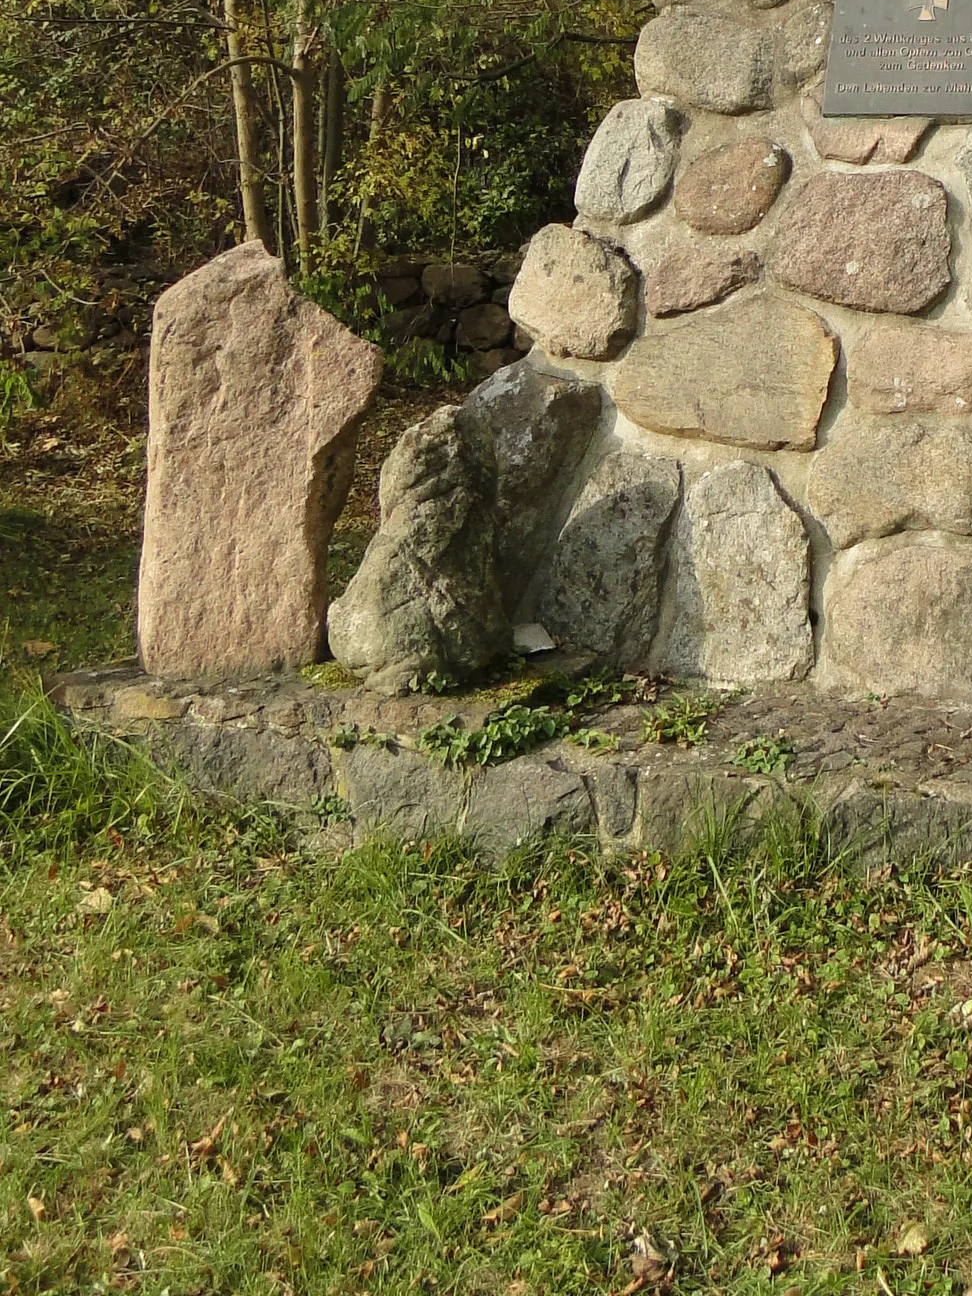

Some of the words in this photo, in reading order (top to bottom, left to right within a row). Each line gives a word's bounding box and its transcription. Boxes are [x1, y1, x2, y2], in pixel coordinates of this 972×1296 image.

[839, 33, 859, 44] des
[845, 46, 867, 57] und
[870, 46, 896, 57] allen
[899, 46, 938, 59] Opfern
[943, 47, 962, 57] von
[879, 61, 903, 70] zum
[836, 82, 860, 94] Den
[863, 82, 919, 94] Lebenden
[923, 84, 942, 93] zur
